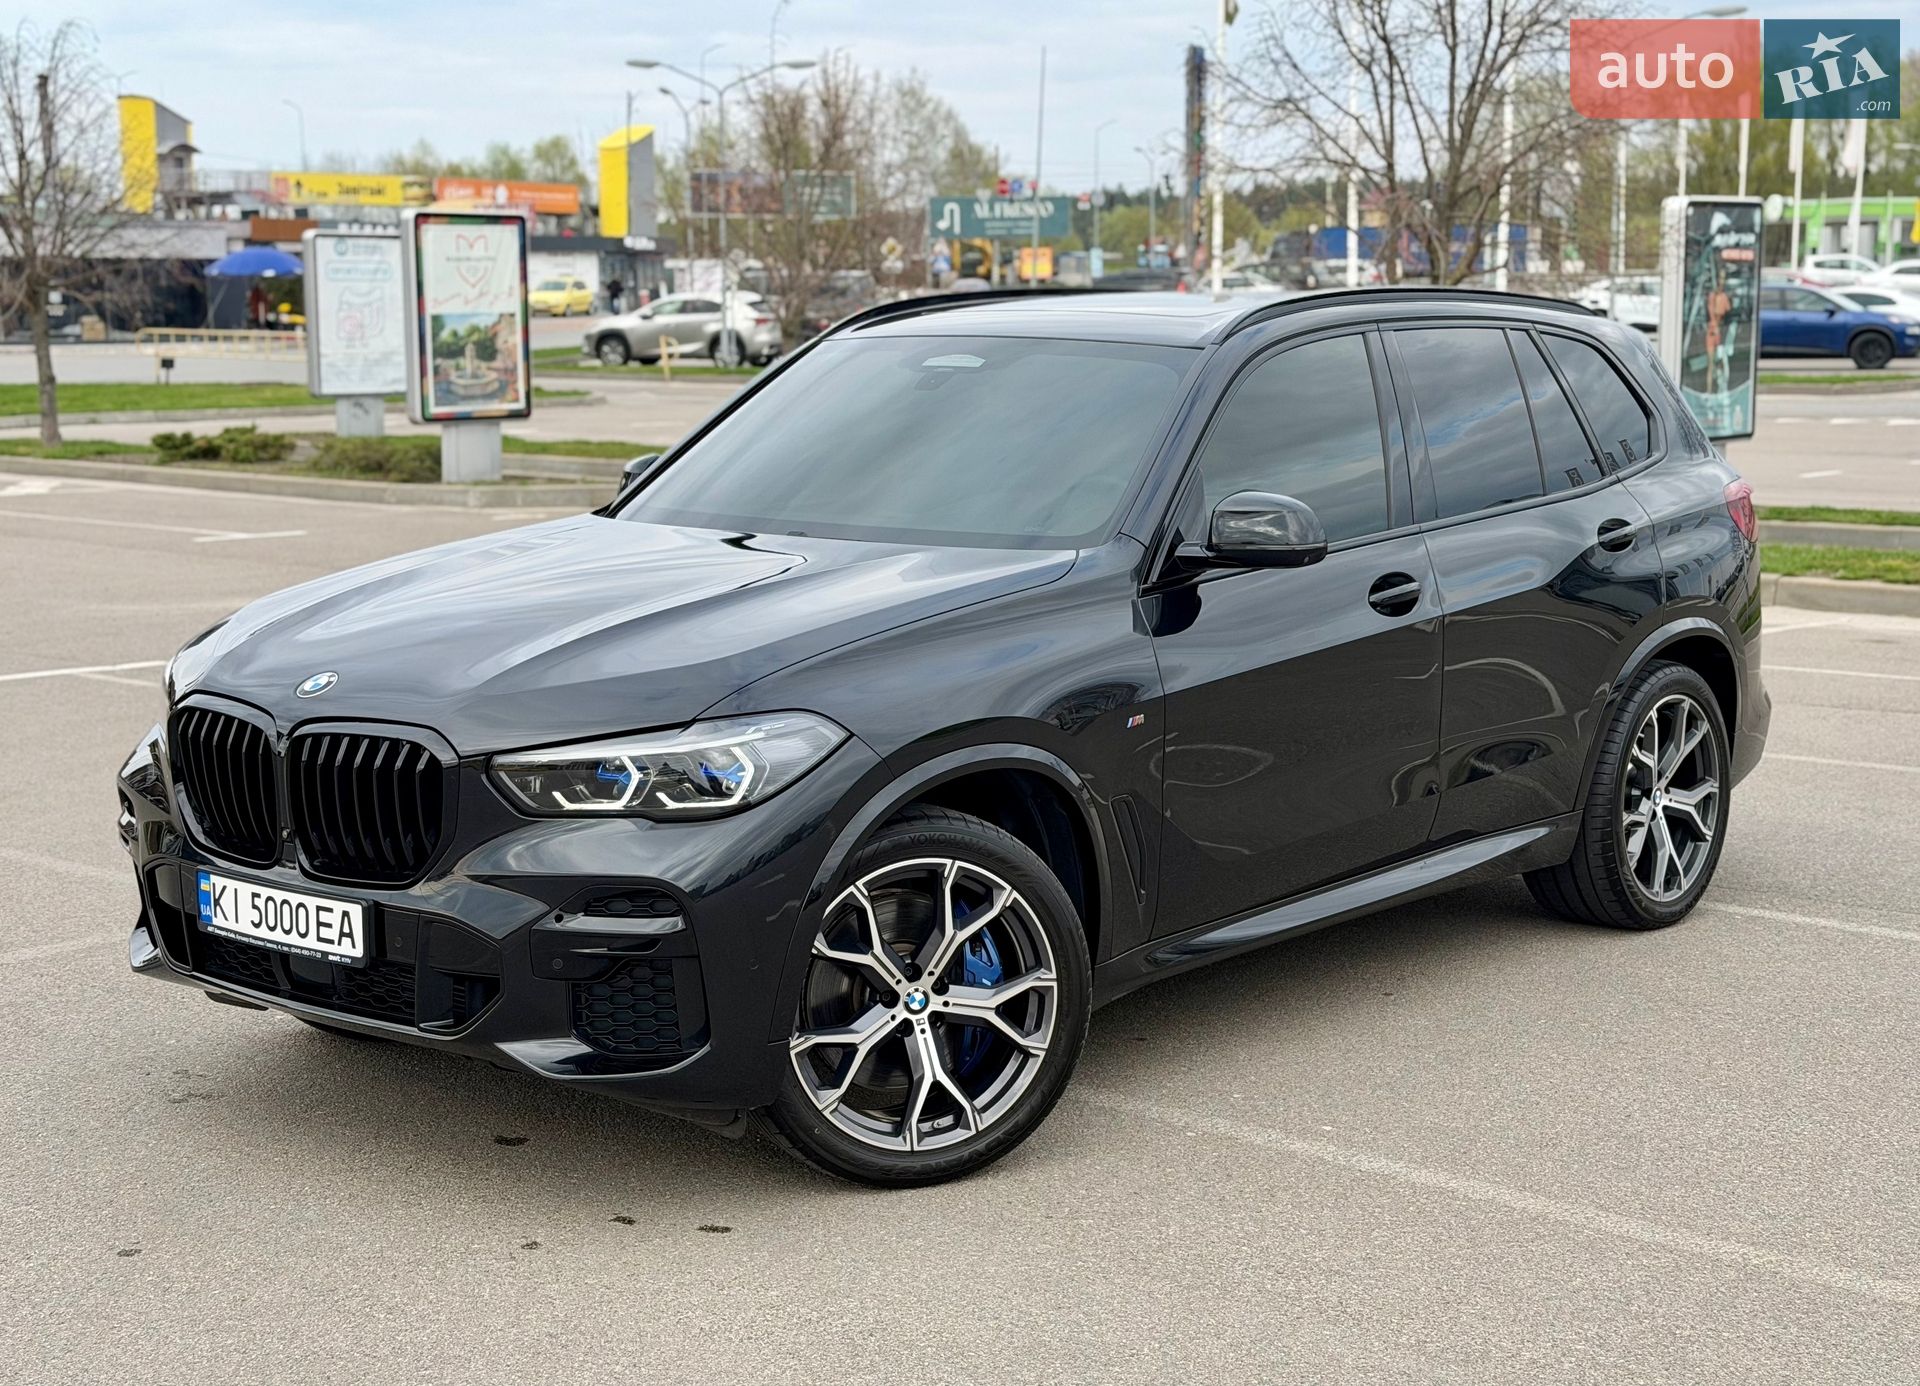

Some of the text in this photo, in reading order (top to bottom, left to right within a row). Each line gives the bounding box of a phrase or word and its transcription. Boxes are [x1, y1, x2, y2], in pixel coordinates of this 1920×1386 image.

[201, 904, 212, 917] UA
[212, 882, 356, 950] KI 5000 EA
